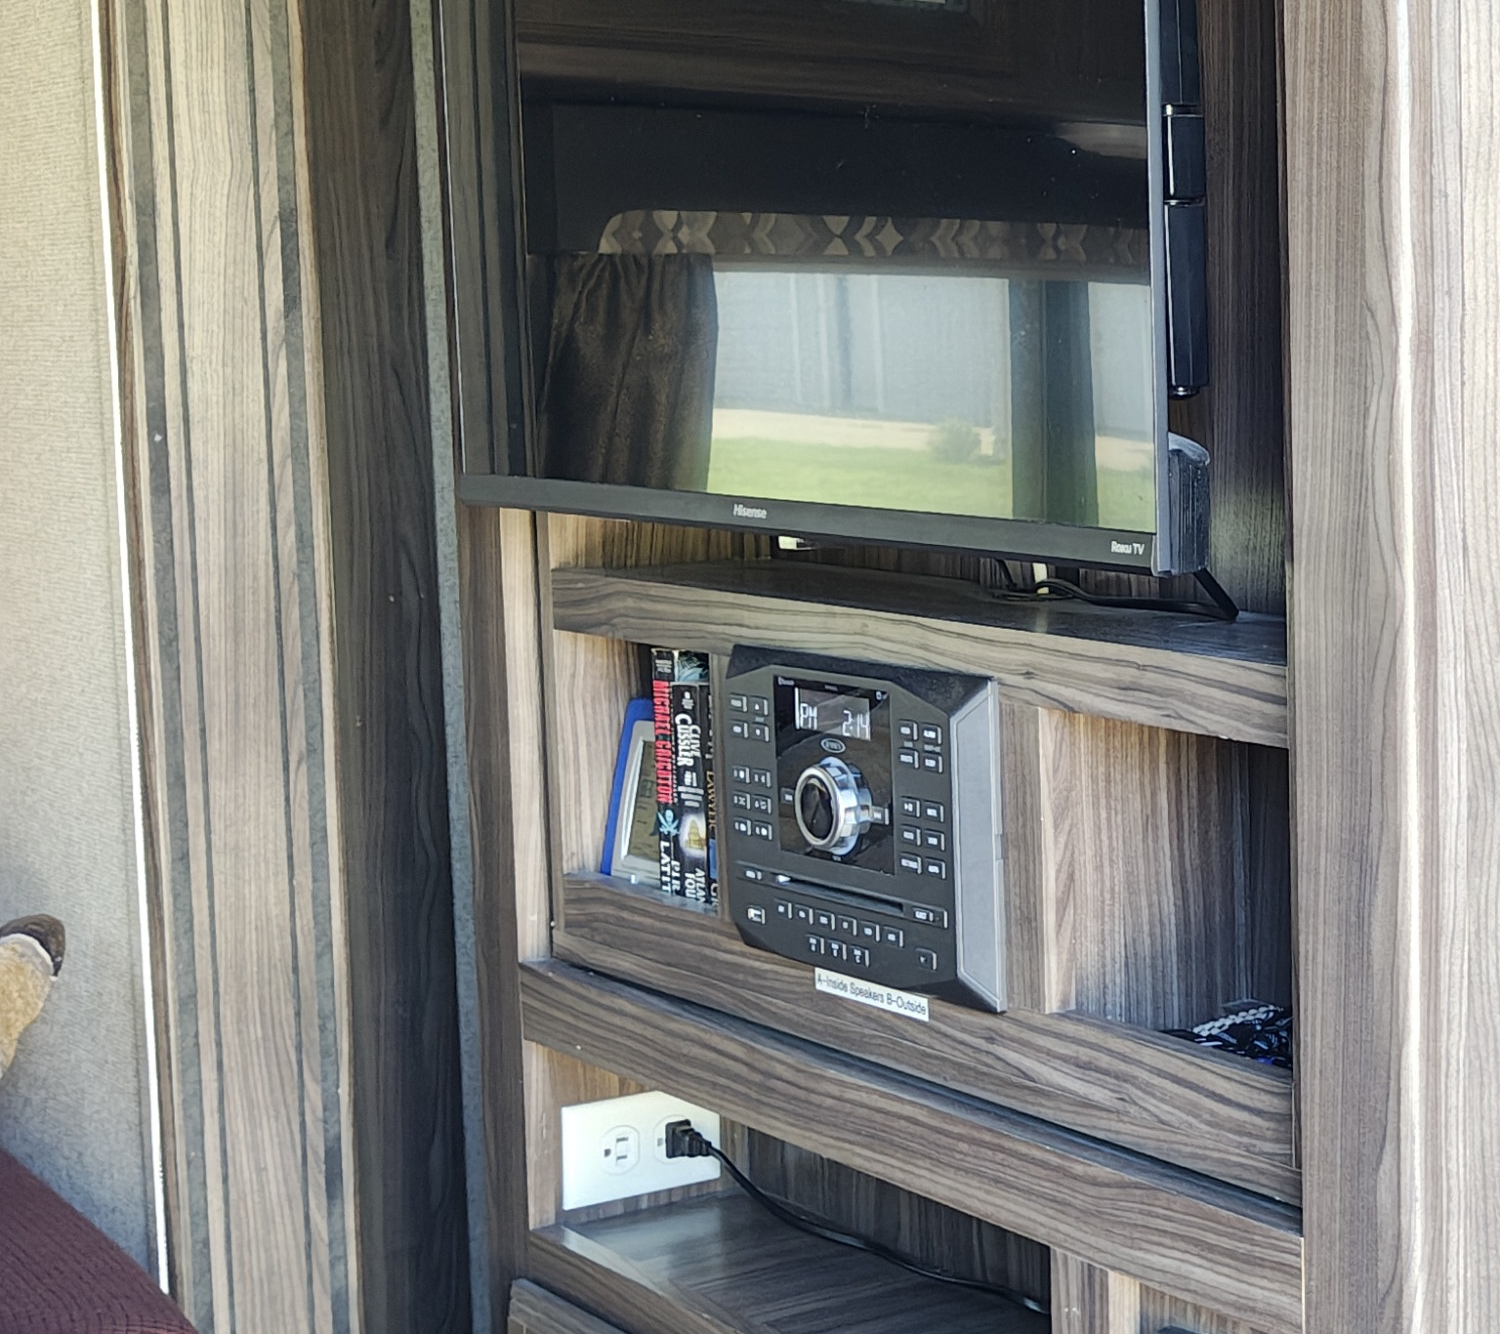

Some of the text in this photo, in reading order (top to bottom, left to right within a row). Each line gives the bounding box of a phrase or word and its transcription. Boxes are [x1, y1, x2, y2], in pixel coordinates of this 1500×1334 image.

[733, 503, 767, 519] Hisense
[1111, 540, 1145, 555] Roku TV
[653, 680, 671, 736] MICHAEL
[842, 710, 871, 741] 2:14
[675, 713, 694, 767] CUSSLER
[690, 725, 701, 758] CLIVE
[655, 740, 674, 804] CRICHTON
[817, 973, 927, 1016] A-Inside Speakers B-Outside
